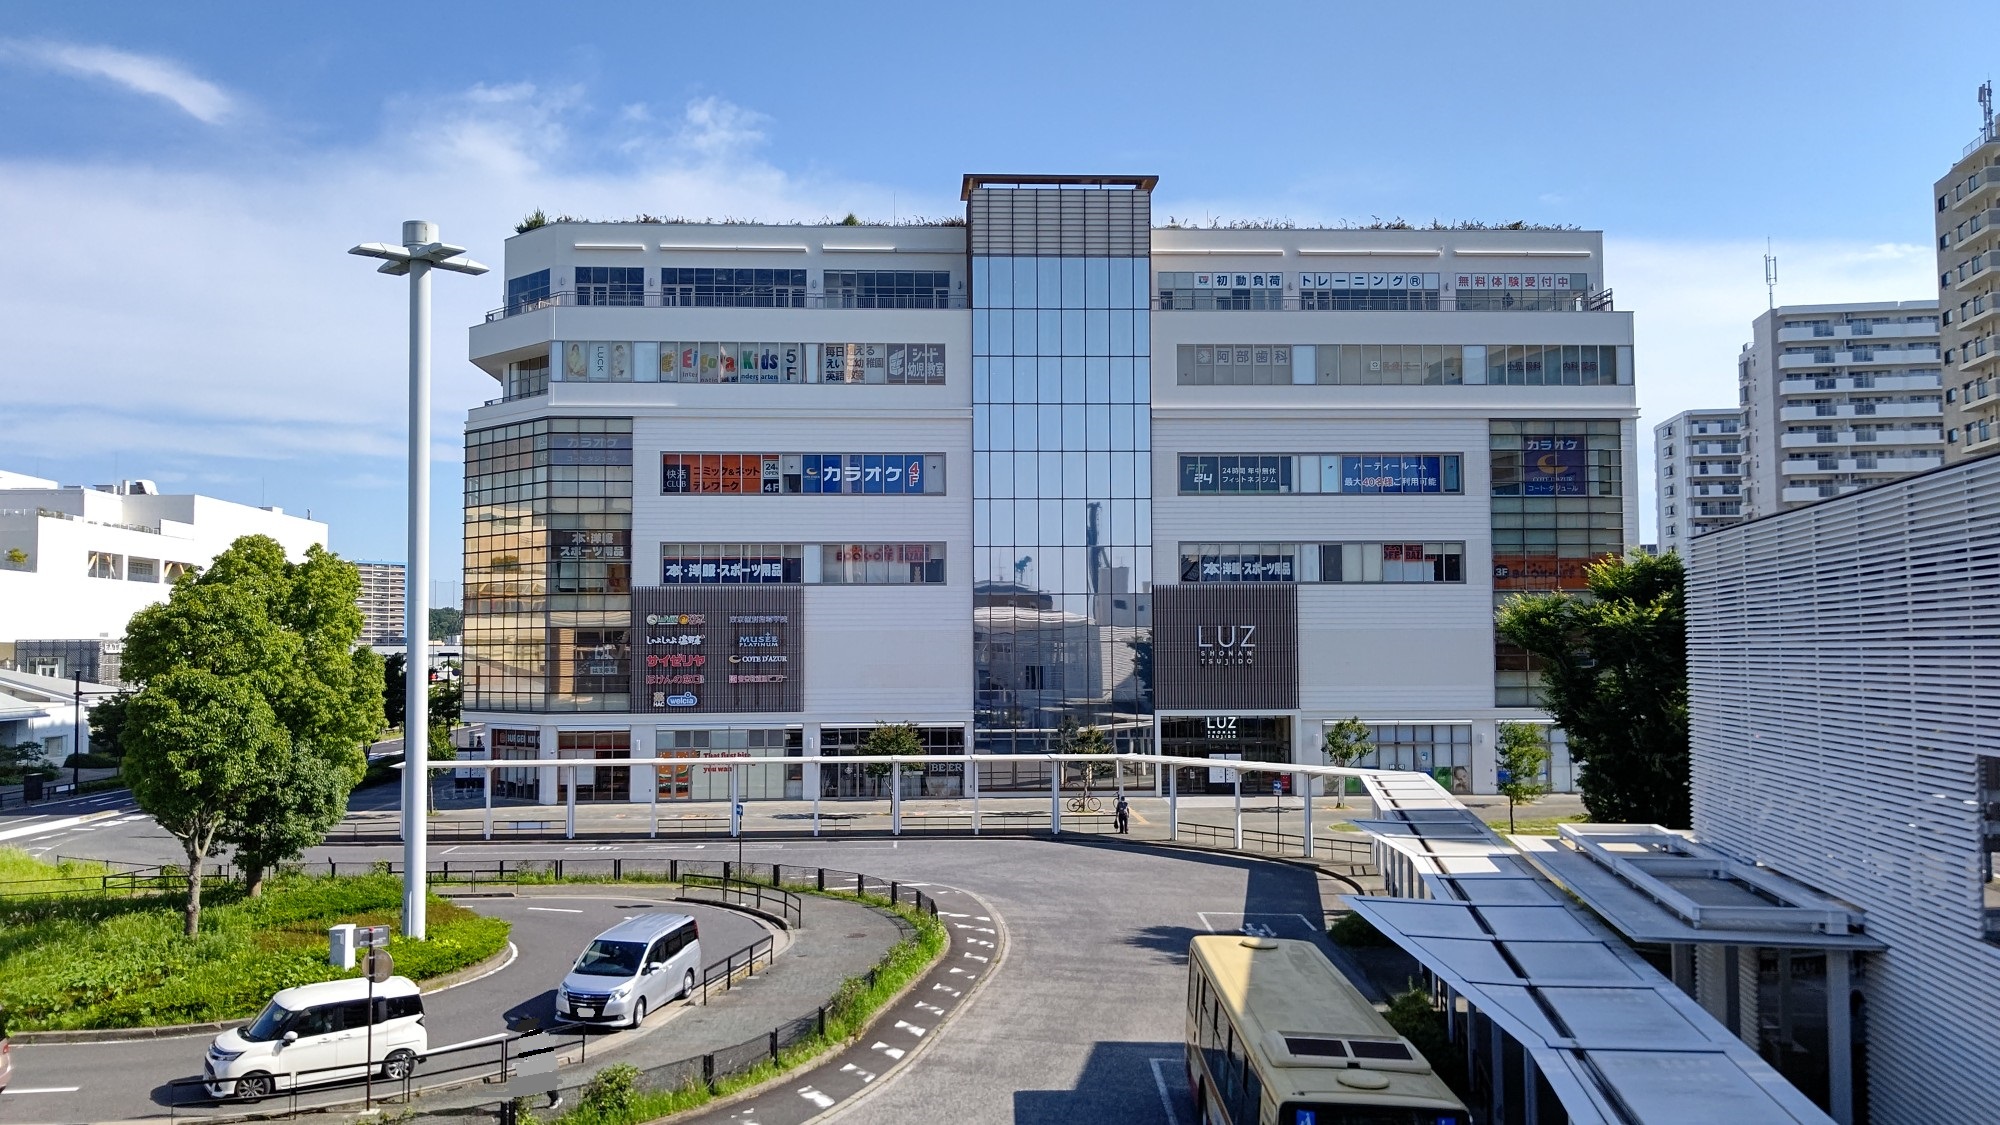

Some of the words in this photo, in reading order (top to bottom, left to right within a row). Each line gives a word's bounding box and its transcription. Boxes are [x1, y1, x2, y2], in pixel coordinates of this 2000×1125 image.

[1217, 275, 1280, 287] 初動負荷
[1458, 276, 1568, 288] 無料体験受付中
[743, 348, 779, 370] Kids
[912, 348, 939, 362] シード
[1527, 440, 1578, 450] カラオケ
[667, 469, 687, 480] 快活
[824, 466, 902, 482] カラオケ
[1222, 467, 1246, 475] 24時間
[667, 480, 687, 488] CLUB
[1194, 473, 1213, 485] 24
[693, 481, 739, 491] テレワーク
[764, 483, 779, 492] 4F
[1495, 567, 1508, 576] 3F
[1198, 625, 1256, 648] LUZ
[646, 654, 706, 667] サイゼリヤ
[1200, 658, 1253, 666] TSUJIDO
[669, 697, 694, 705] welcia
[1206, 716, 1237, 729] LUZ
[703, 766, 717, 774] you
[931, 763, 963, 772] BEER
